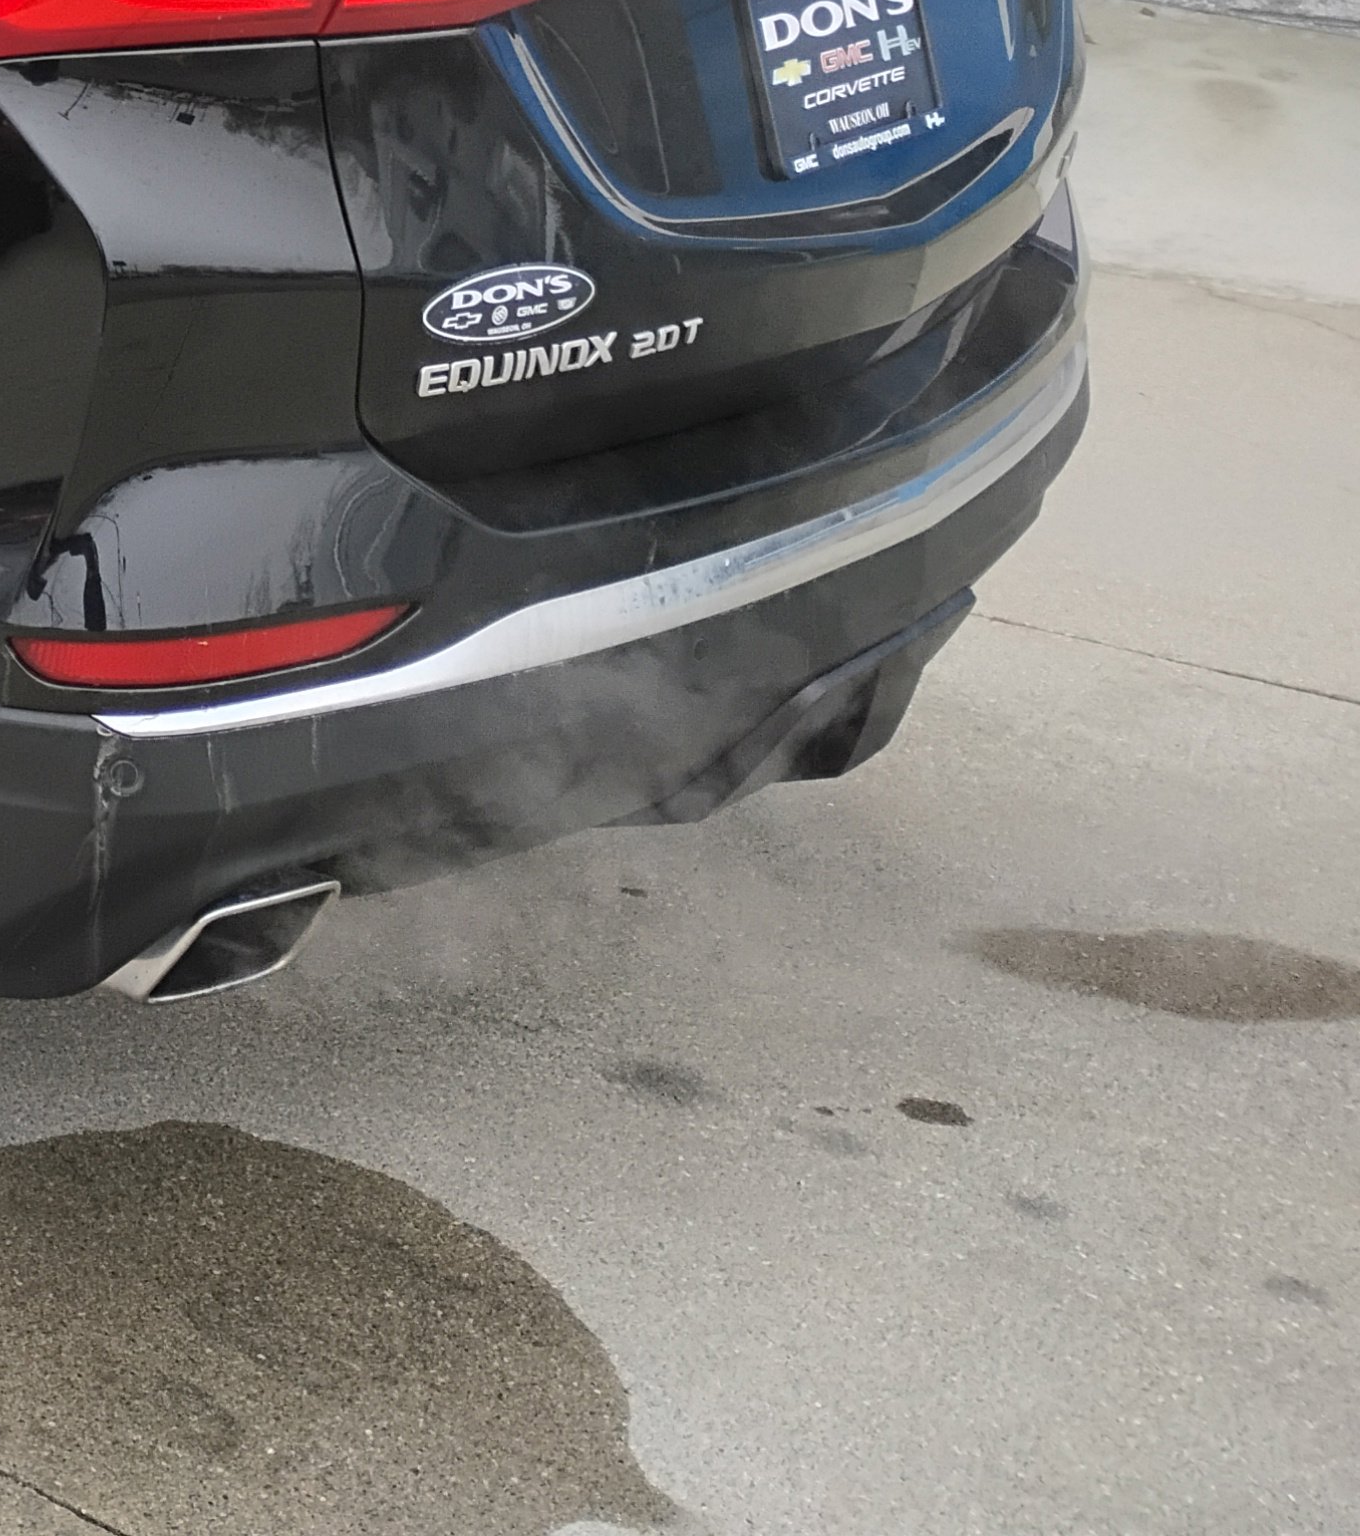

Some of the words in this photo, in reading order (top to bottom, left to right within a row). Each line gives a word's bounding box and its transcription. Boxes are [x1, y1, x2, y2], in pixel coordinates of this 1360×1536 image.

[820, 39, 874, 74] GMC
[803, 66, 906, 110] CORVETTE
[828, 107, 877, 134] WAUSEON,
[793, 154, 819, 173] GMC
[450, 274, 573, 311] DON'S
[516, 302, 549, 318] GMC
[418, 331, 618, 398] EQUINOX
